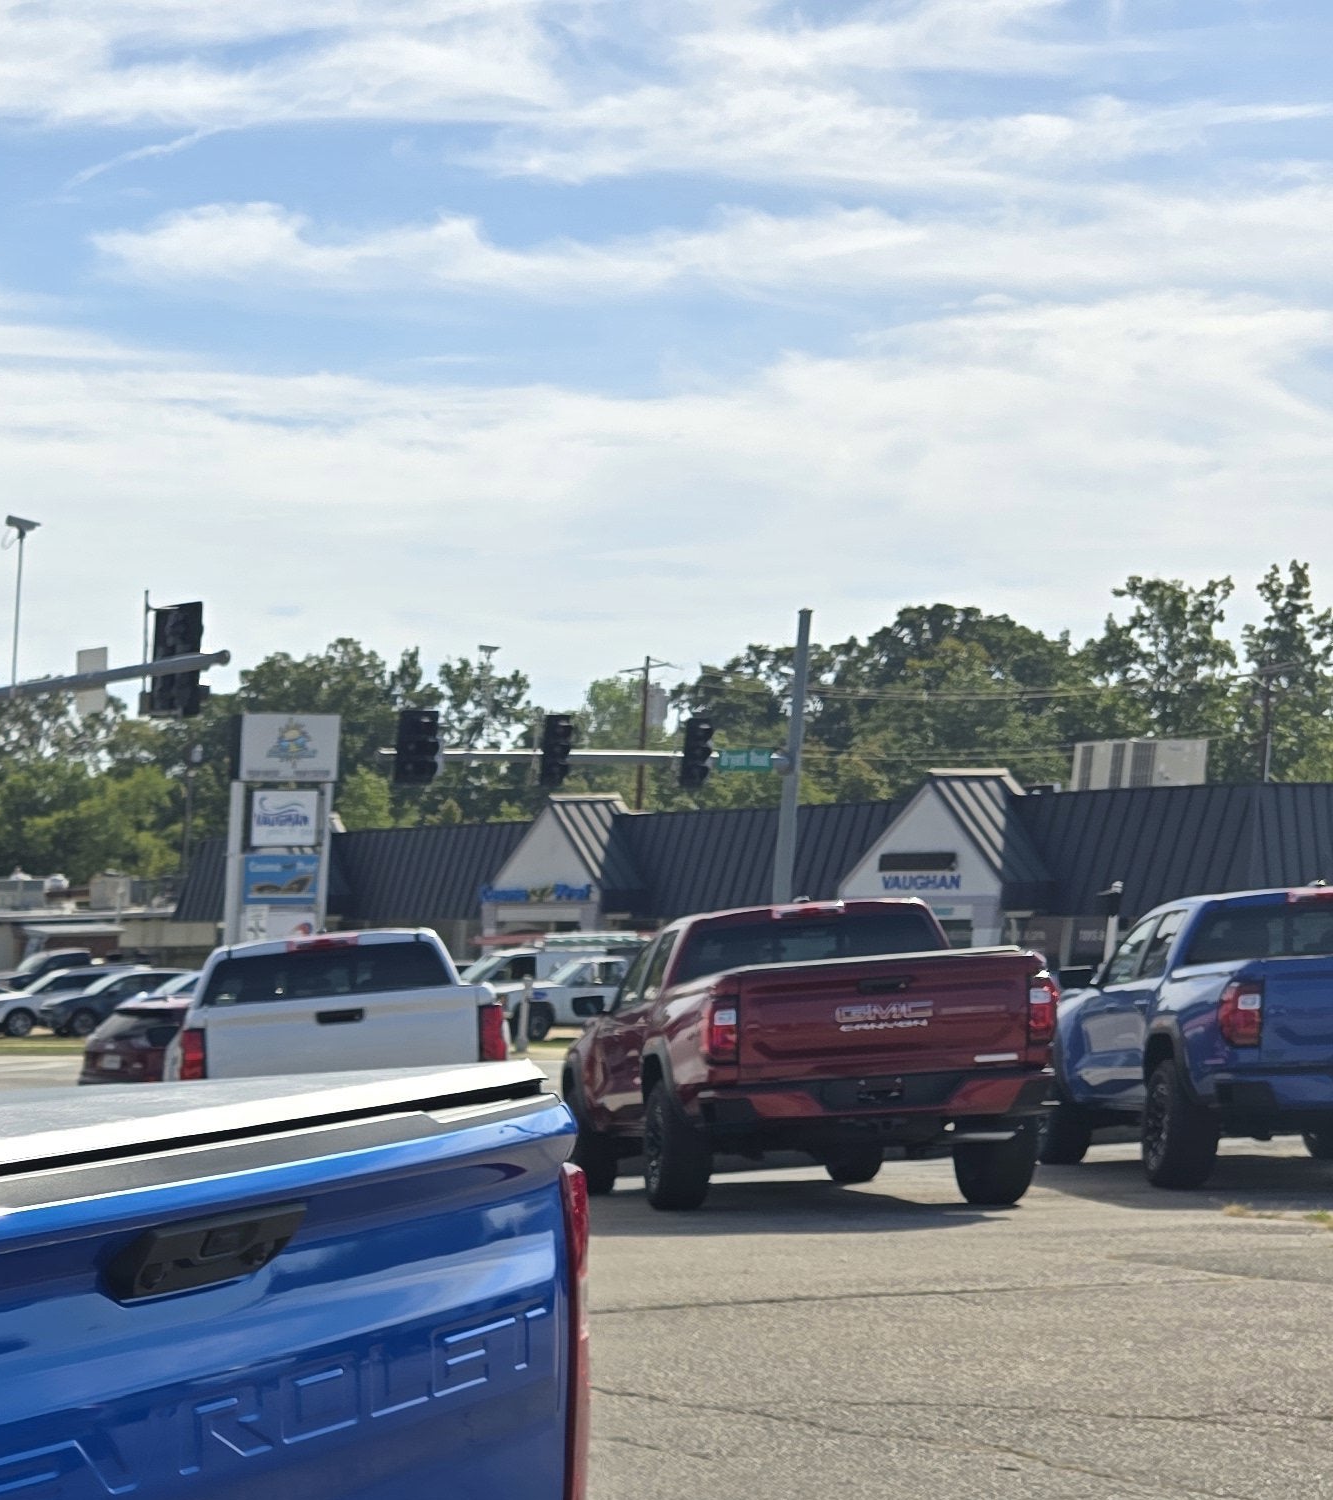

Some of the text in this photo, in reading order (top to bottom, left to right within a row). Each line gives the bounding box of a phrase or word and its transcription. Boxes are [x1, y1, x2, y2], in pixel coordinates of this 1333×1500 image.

[882, 874, 961, 891] VAUGHAN
[835, 1001, 934, 1023] GMC
[839, 1019, 929, 1033] CANYON
